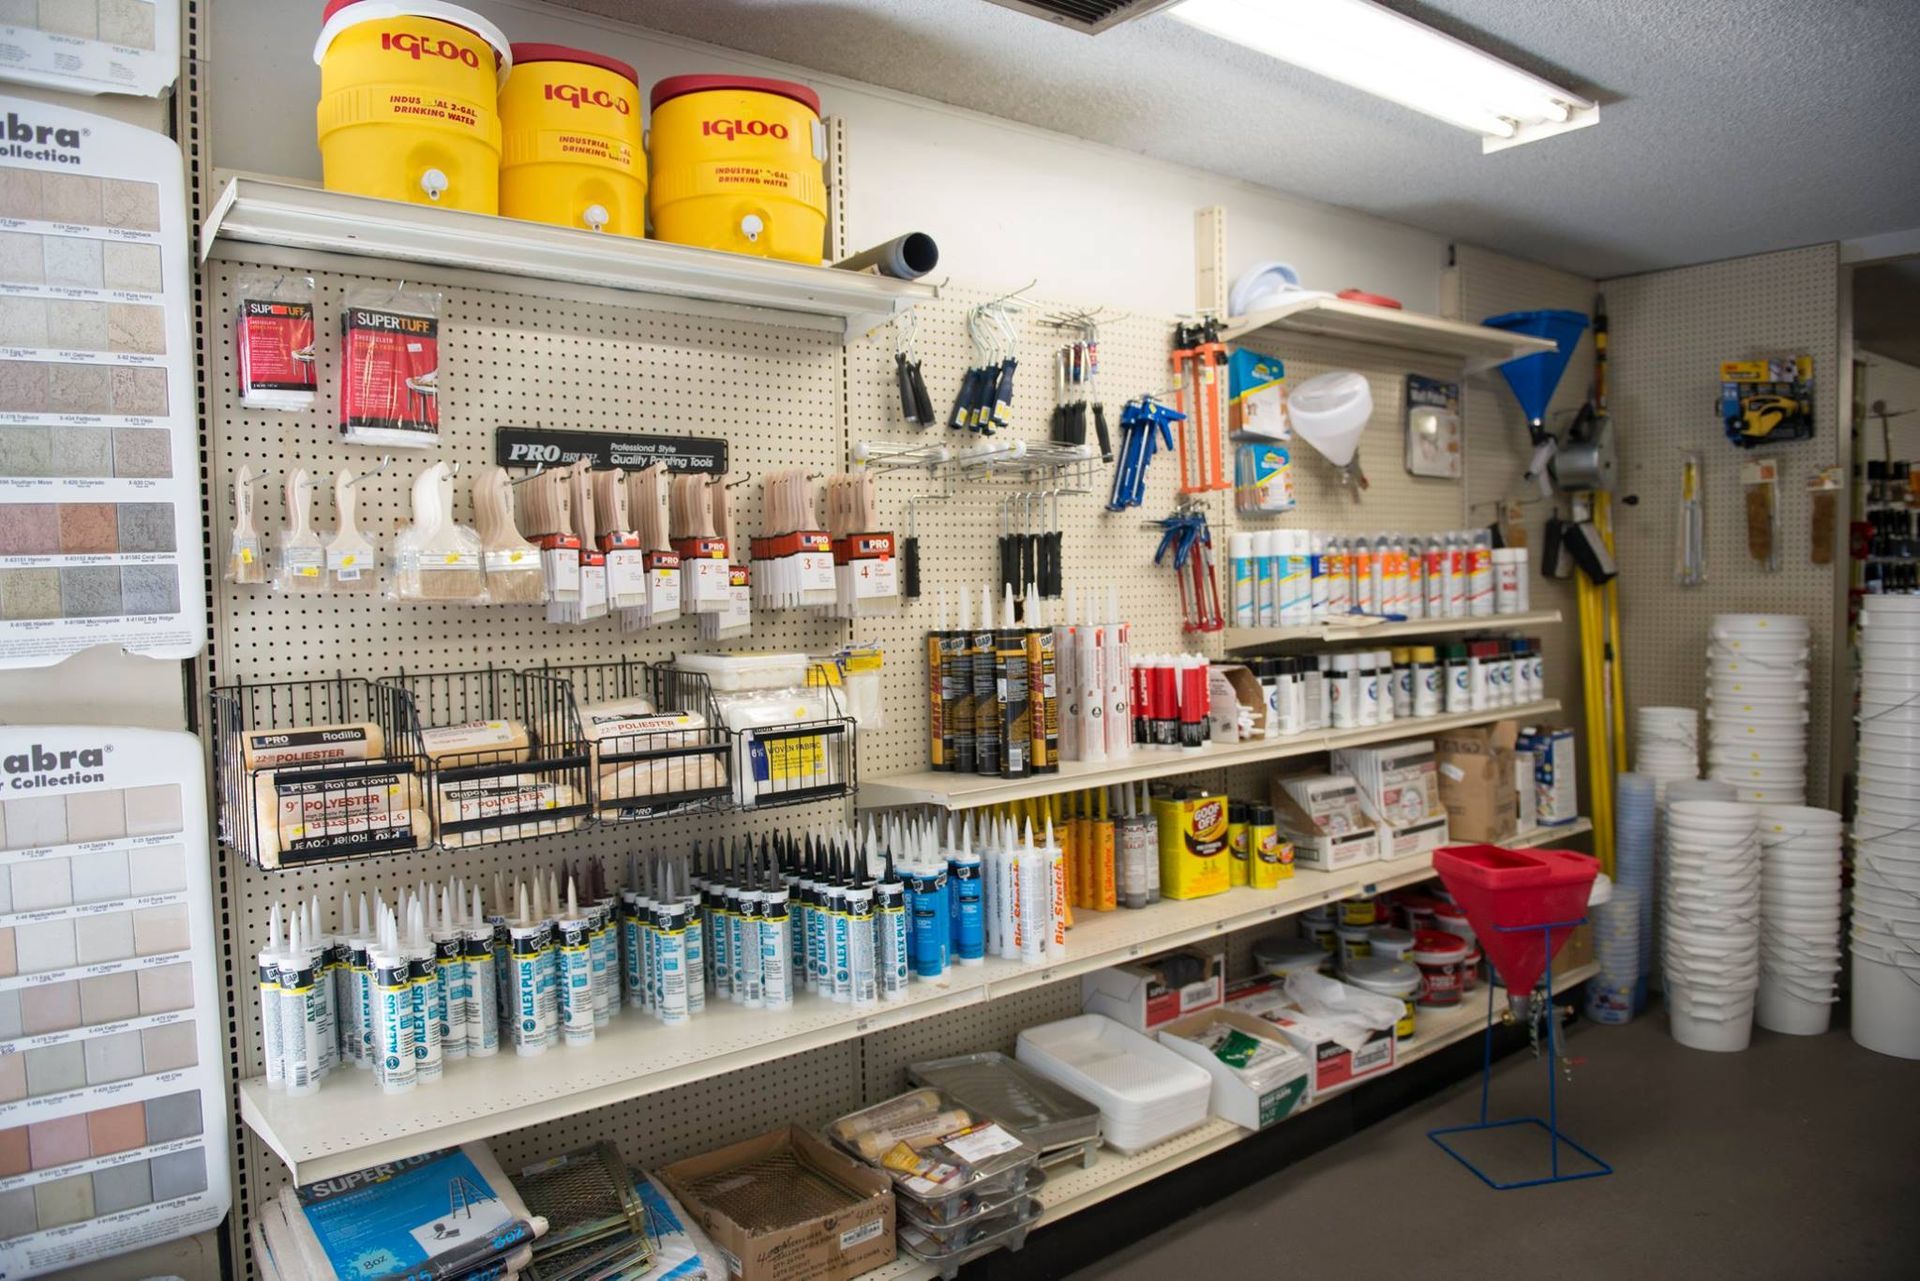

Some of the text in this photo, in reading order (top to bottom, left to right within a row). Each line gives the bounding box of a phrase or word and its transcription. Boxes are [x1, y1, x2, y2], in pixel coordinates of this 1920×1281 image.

[381, 32, 479, 68] IGLOO
[544, 84, 630, 115] IGLOO
[394, 105, 476, 126] DRINKING WATER
[0, 111, 80, 148] bra
[702, 119, 789, 141] IGLOO
[559, 135, 610, 149] INDUSTRIAL
[562, 144, 607, 158] DRINKING
[0, 144, 81, 164] ollection
[718, 175, 788, 188] DRINKING WATER
[357, 312, 430, 333] SUPERTUFF
[508, 443, 561, 462] PRO
[610, 442, 676, 454] Professional Style
[610, 454, 647, 467] Quality
[690, 457, 713, 467] Tools
[708, 542, 725, 551] PRO
[810, 536, 829, 544] PRO
[869, 540, 889, 549] PRO
[661, 556, 679, 564] PRO
[618, 719, 674, 731] POLIESTER
[265, 729, 362, 745] PRO Rodillo
[2, 744, 104, 775] abra
[276, 749, 345, 763] POLIESTER
[11, 771, 105, 789] Collection
[304, 794, 380, 812] POLYESTER
[478, 791, 545, 809] POLYESTER
[1194, 802, 1220, 821] GOOF
[1198, 814, 1217, 830] OFF
[1053, 863, 1064, 917] Stretch
[715, 915, 725, 964] ALEX PLUS
[816, 913, 826, 963] ALEX PLUS
[836, 918, 848, 969] ALEX PLUS
[896, 914, 906, 963] ALEX PLUS
[437, 967, 448, 1021] ALEX PLUS
[521, 961, 534, 1016] ALEX PLUS
[386, 994, 398, 1053] ALEX PLUS
[412, 985, 426, 1043] ALEX PLUS
[363, 1254, 388, 1270] 8oz
